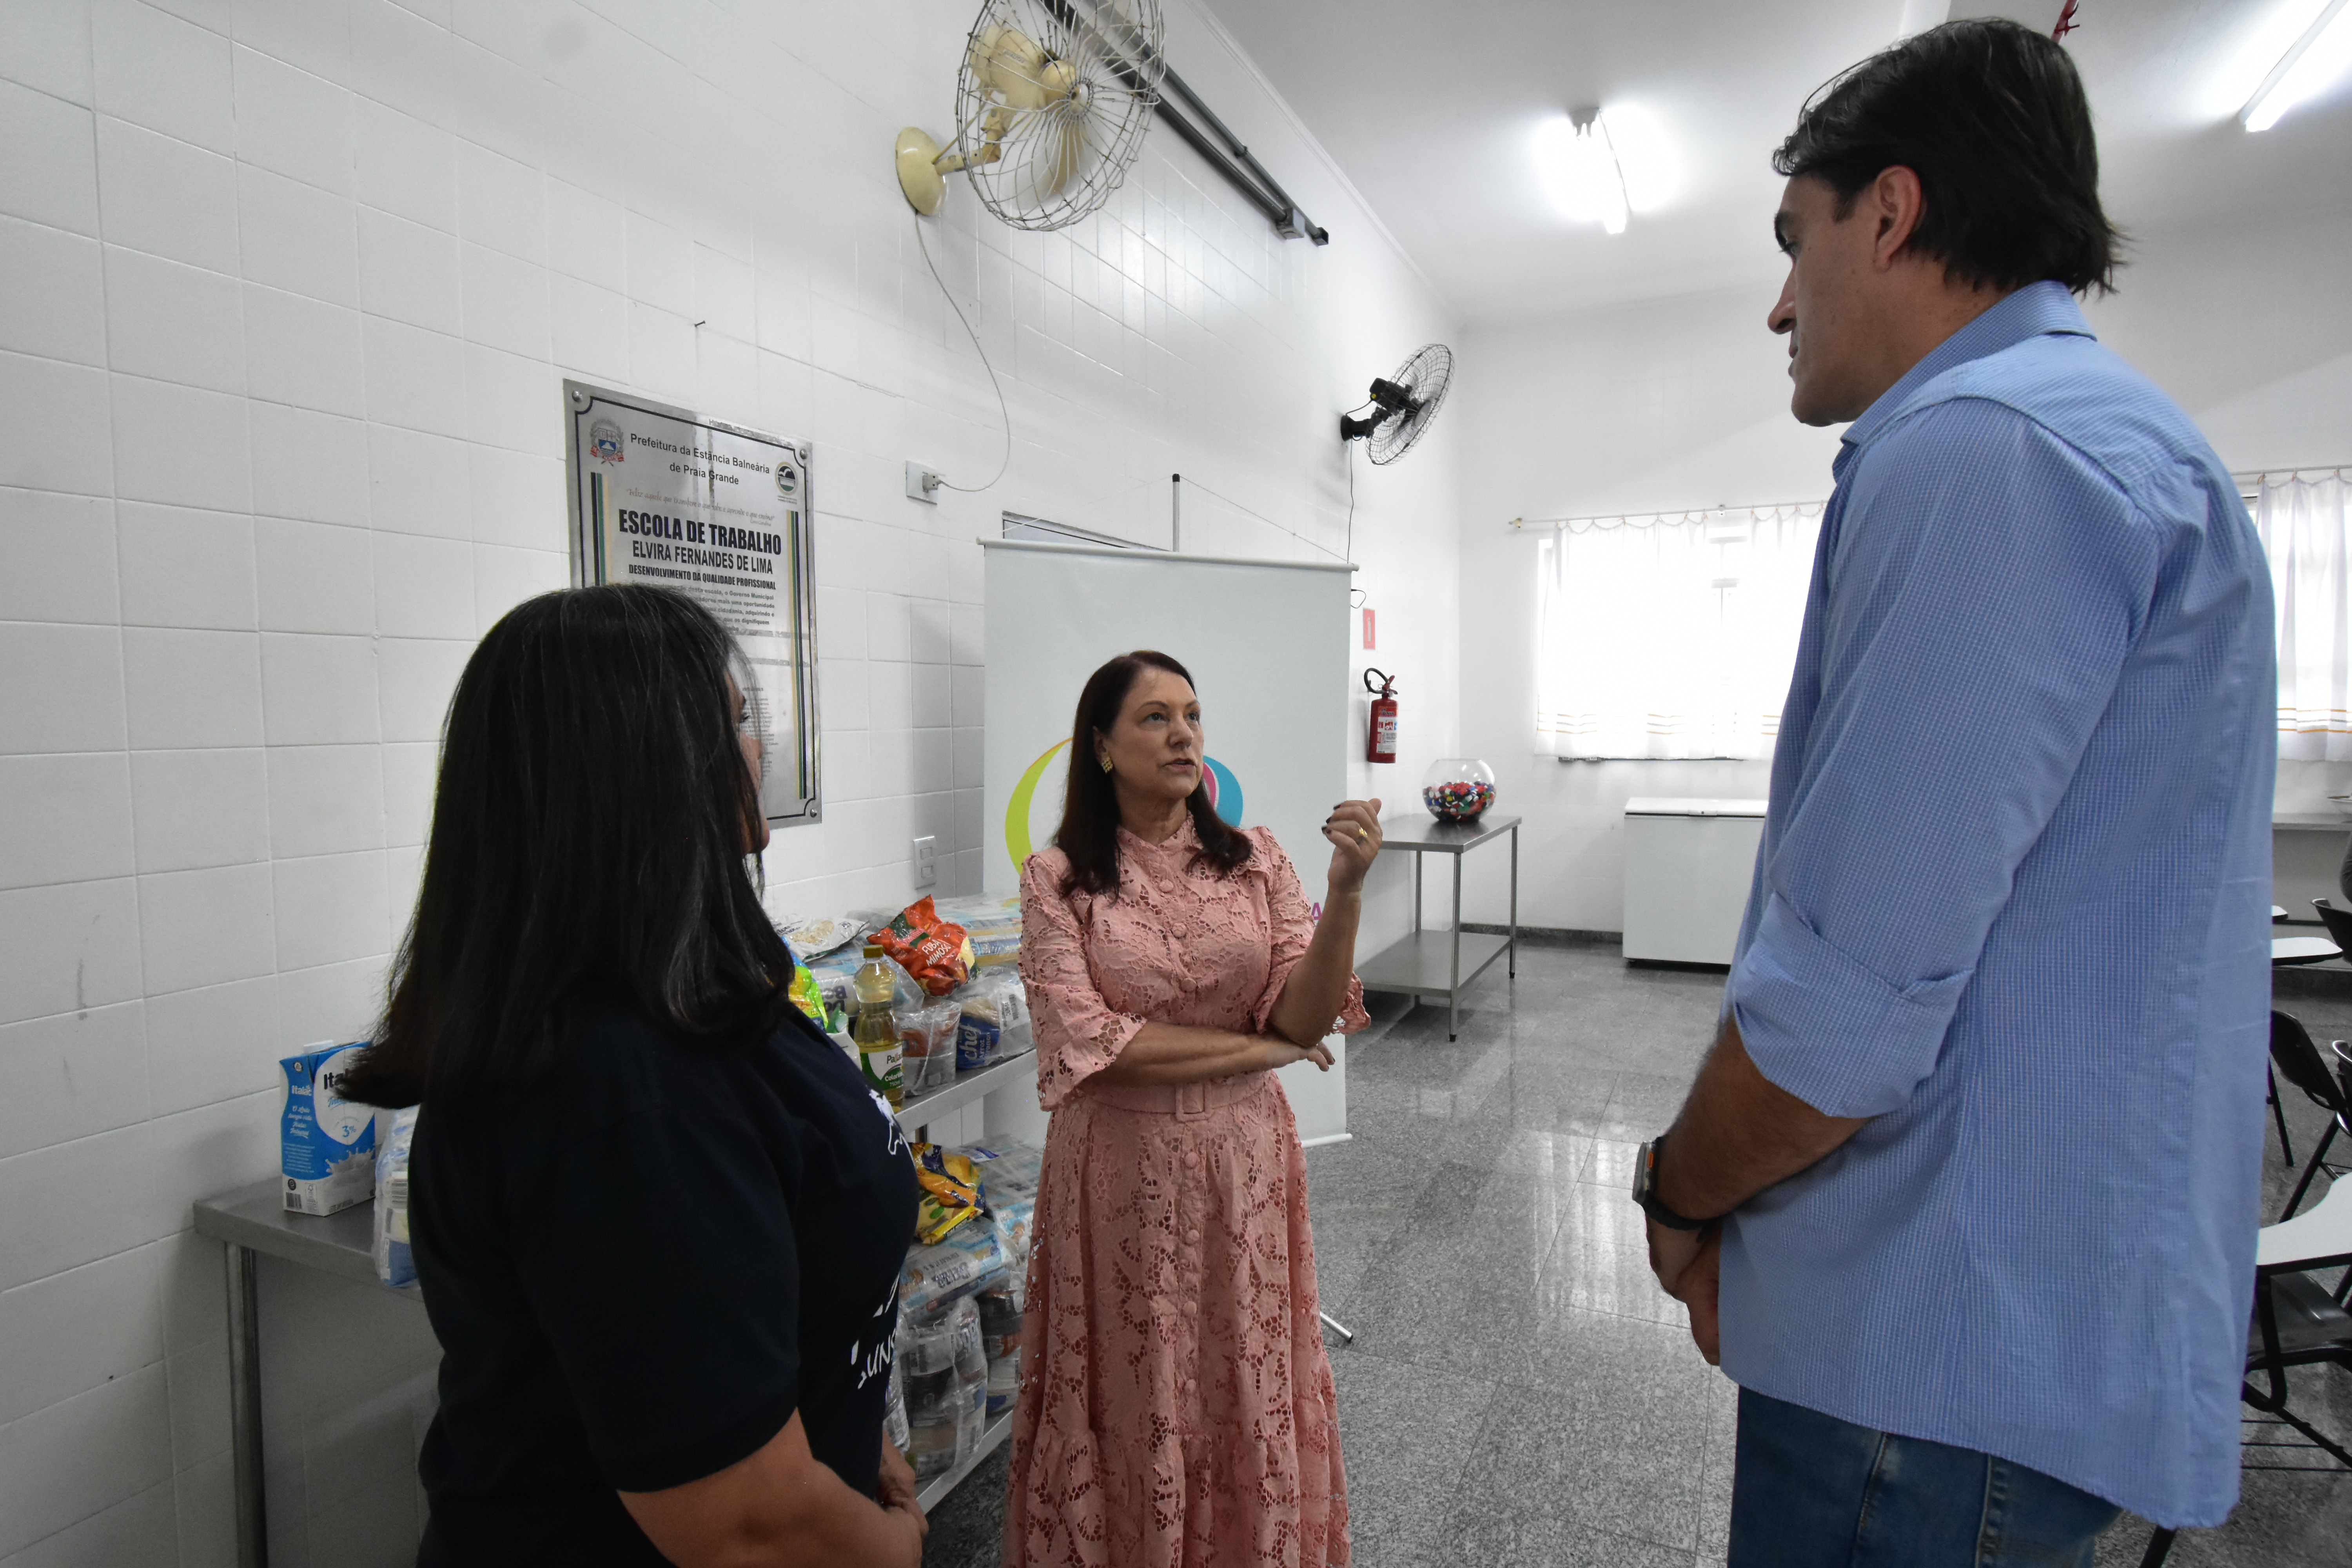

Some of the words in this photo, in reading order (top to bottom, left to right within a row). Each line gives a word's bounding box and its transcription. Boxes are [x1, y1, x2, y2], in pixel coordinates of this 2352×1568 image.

[630, 433, 677, 452] Prefeitura
[680, 445, 691, 455] da
[693, 448, 730, 465] Estância
[732, 457, 769, 474] Balneária
[670, 463, 681, 472] de
[684, 465, 706, 477] Praia
[709, 470, 739, 485] Grande
[619, 509, 683, 541] ESCOLA
[686, 520, 706, 544] DE
[708, 523, 781, 555] TRABALHO
[633, 540, 671, 561] ELVIRA
[675, 546, 734, 569] FERNANDES
[736, 554, 748, 571] DE
[751, 556, 773, 574] LIMA
[629, 564, 691, 581] DESENVOLVIMENTO
[692, 572, 701, 582] DA
[702, 573, 735, 586] QUALIDADE
[736, 577, 776, 590] PROFISSIONAL
[959, 1023, 981, 1060] chef
[887, 1053, 902, 1064] Palla
[342, 1125, 356, 1138] 3%
